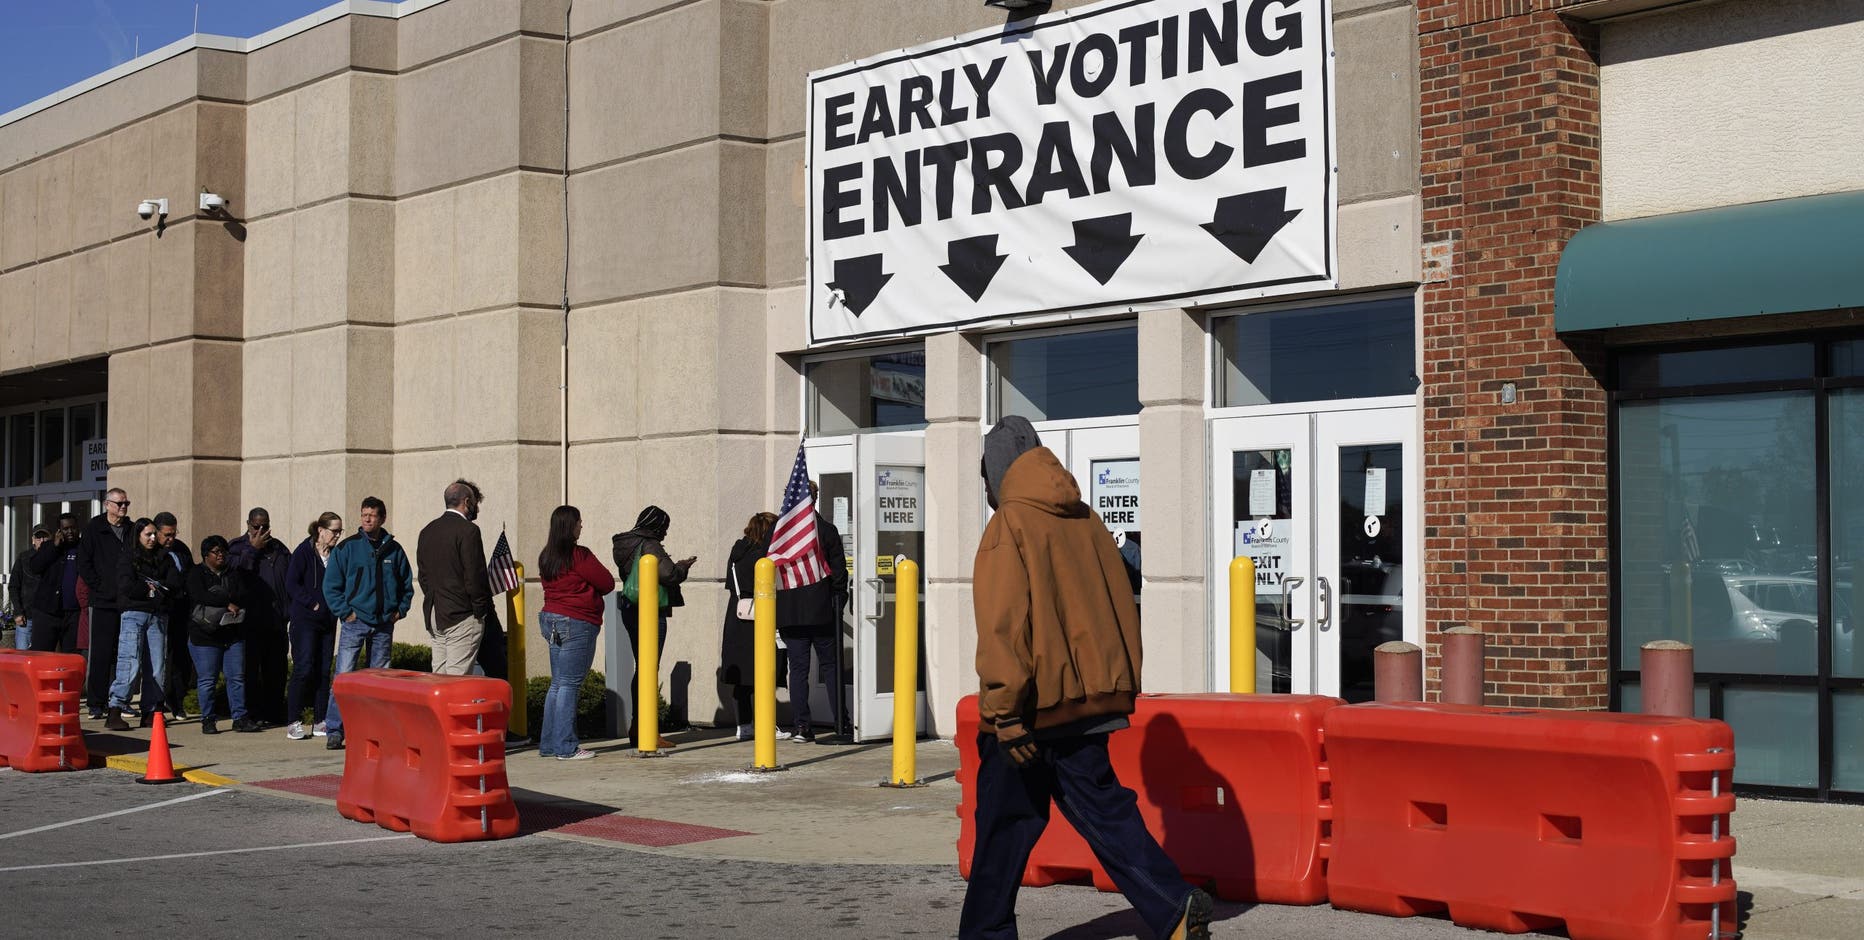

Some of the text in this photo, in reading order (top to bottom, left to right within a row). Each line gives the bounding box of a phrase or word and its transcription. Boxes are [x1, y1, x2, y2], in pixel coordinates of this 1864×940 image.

[824, 0, 1304, 151] EARLY VOTING
[823, 70, 1306, 241] ENTRANCE
[880, 497, 917, 508] ENTER
[1099, 495, 1139, 508] ENTER
[884, 511, 914, 523] HERE
[1103, 511, 1135, 523] HERE
[1273, 536, 1289, 544] County
[1250, 556, 1281, 569] EXIT
[1257, 572, 1285, 585] NLY
